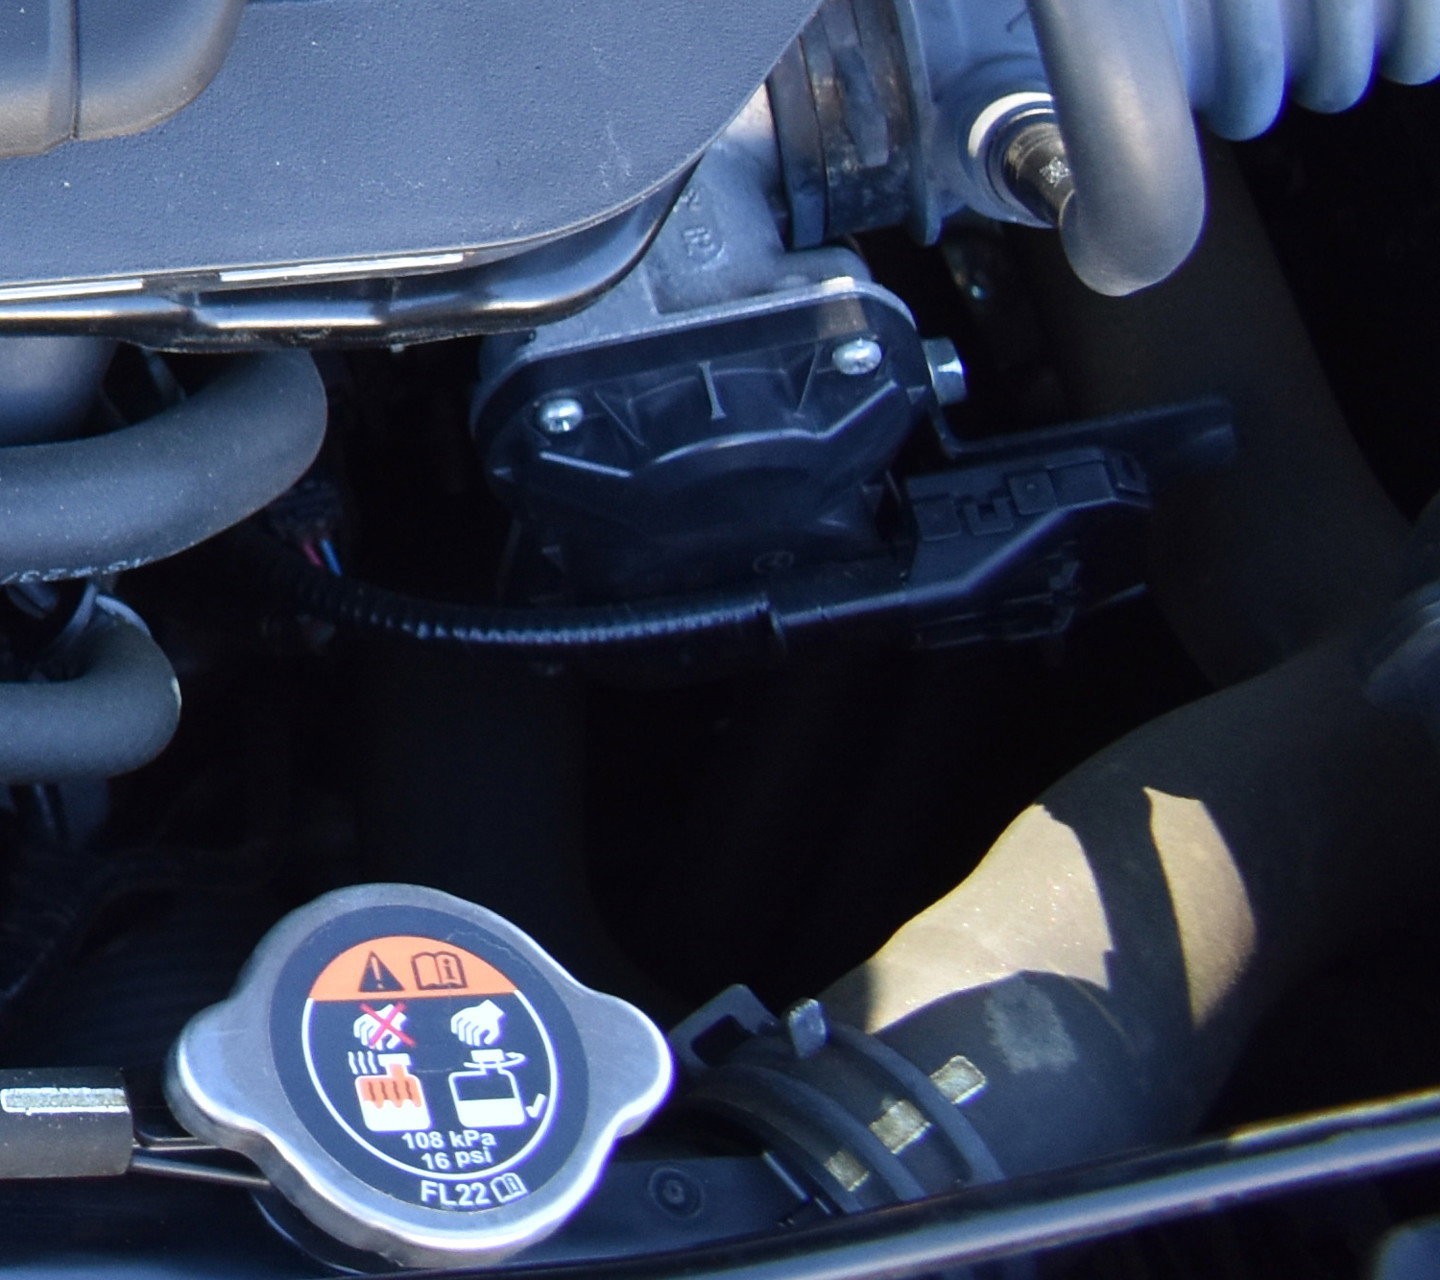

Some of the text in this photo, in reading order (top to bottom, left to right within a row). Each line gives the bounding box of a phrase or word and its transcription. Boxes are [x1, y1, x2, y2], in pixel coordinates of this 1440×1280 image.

[401, 1129, 497, 1150] 108 kPa
[421, 1146, 494, 1170] 16 psi
[420, 1179, 492, 1207] FL22
